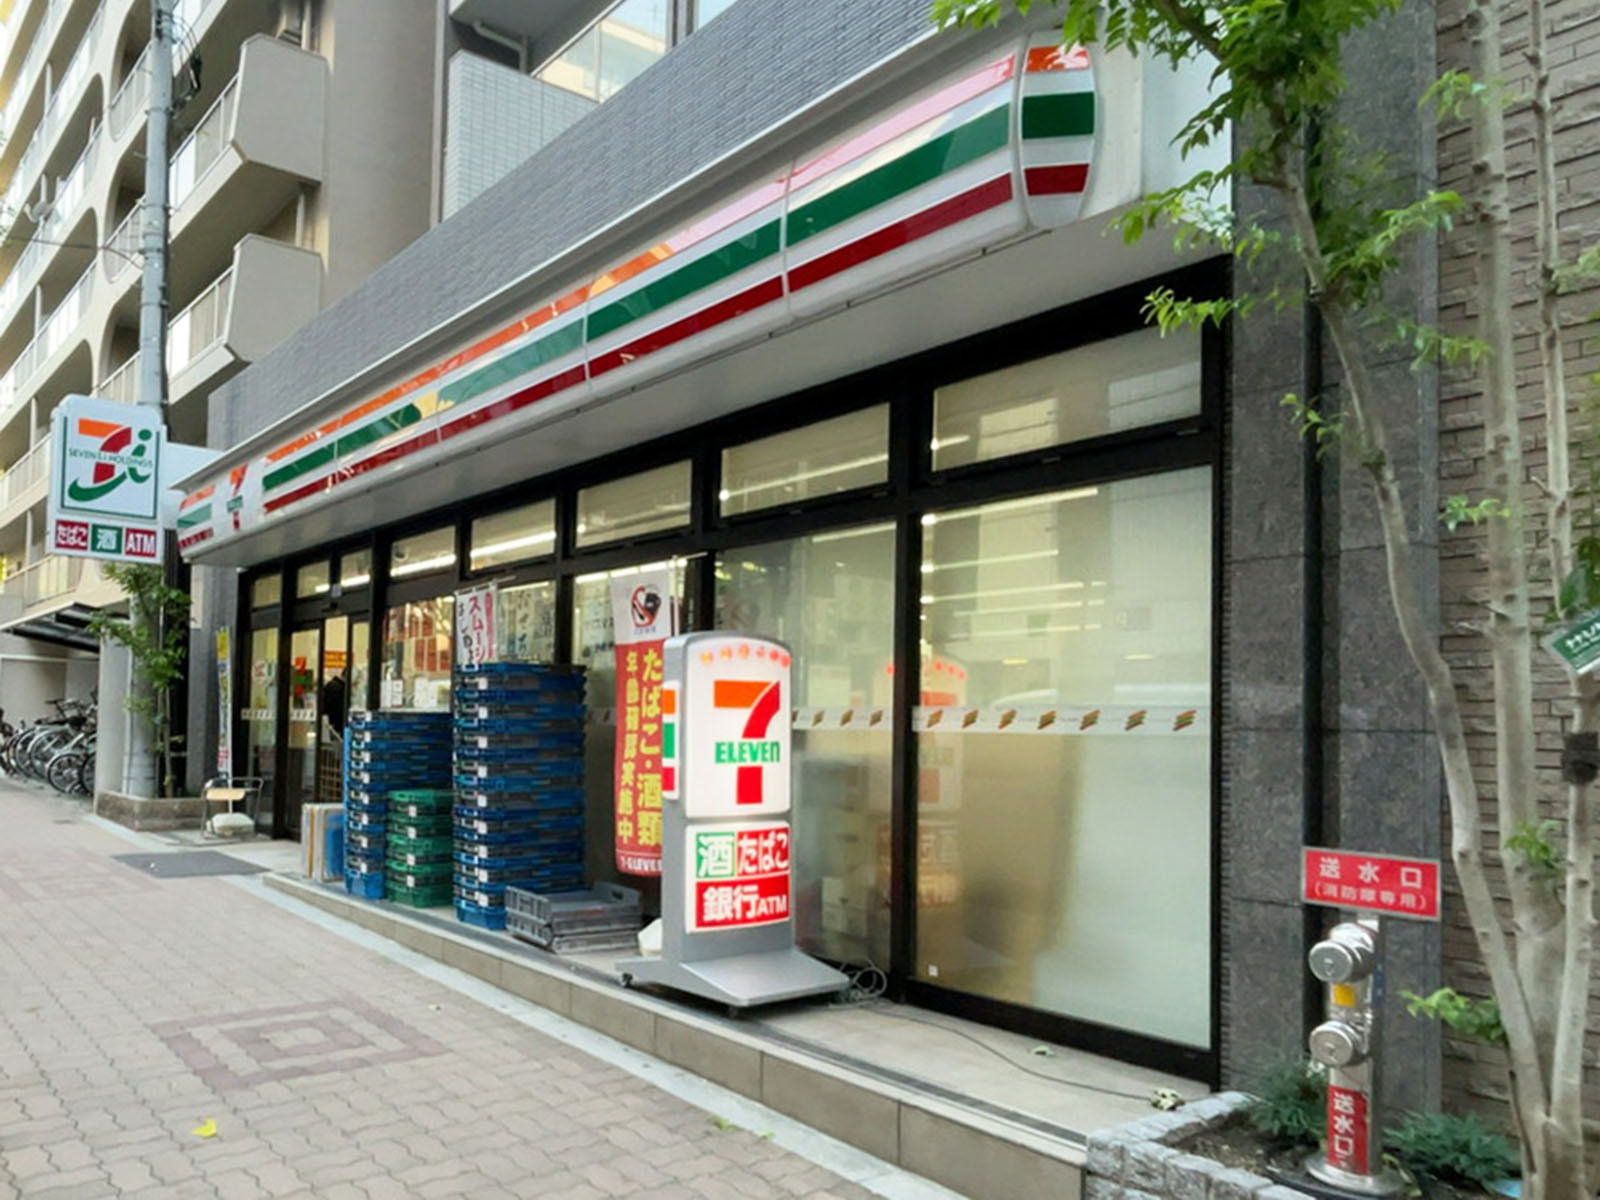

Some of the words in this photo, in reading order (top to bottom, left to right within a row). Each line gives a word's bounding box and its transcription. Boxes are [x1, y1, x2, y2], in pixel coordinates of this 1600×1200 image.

[57, 524, 87, 547] たばこ
[97, 528, 118, 550] 酒
[126, 532, 156, 555] ATM
[698, 835, 735, 877] 酒
[739, 831, 788, 874] たばこ
[1319, 857, 1423, 889] 送水口
[1334, 1090, 1355, 1157] 送水口
